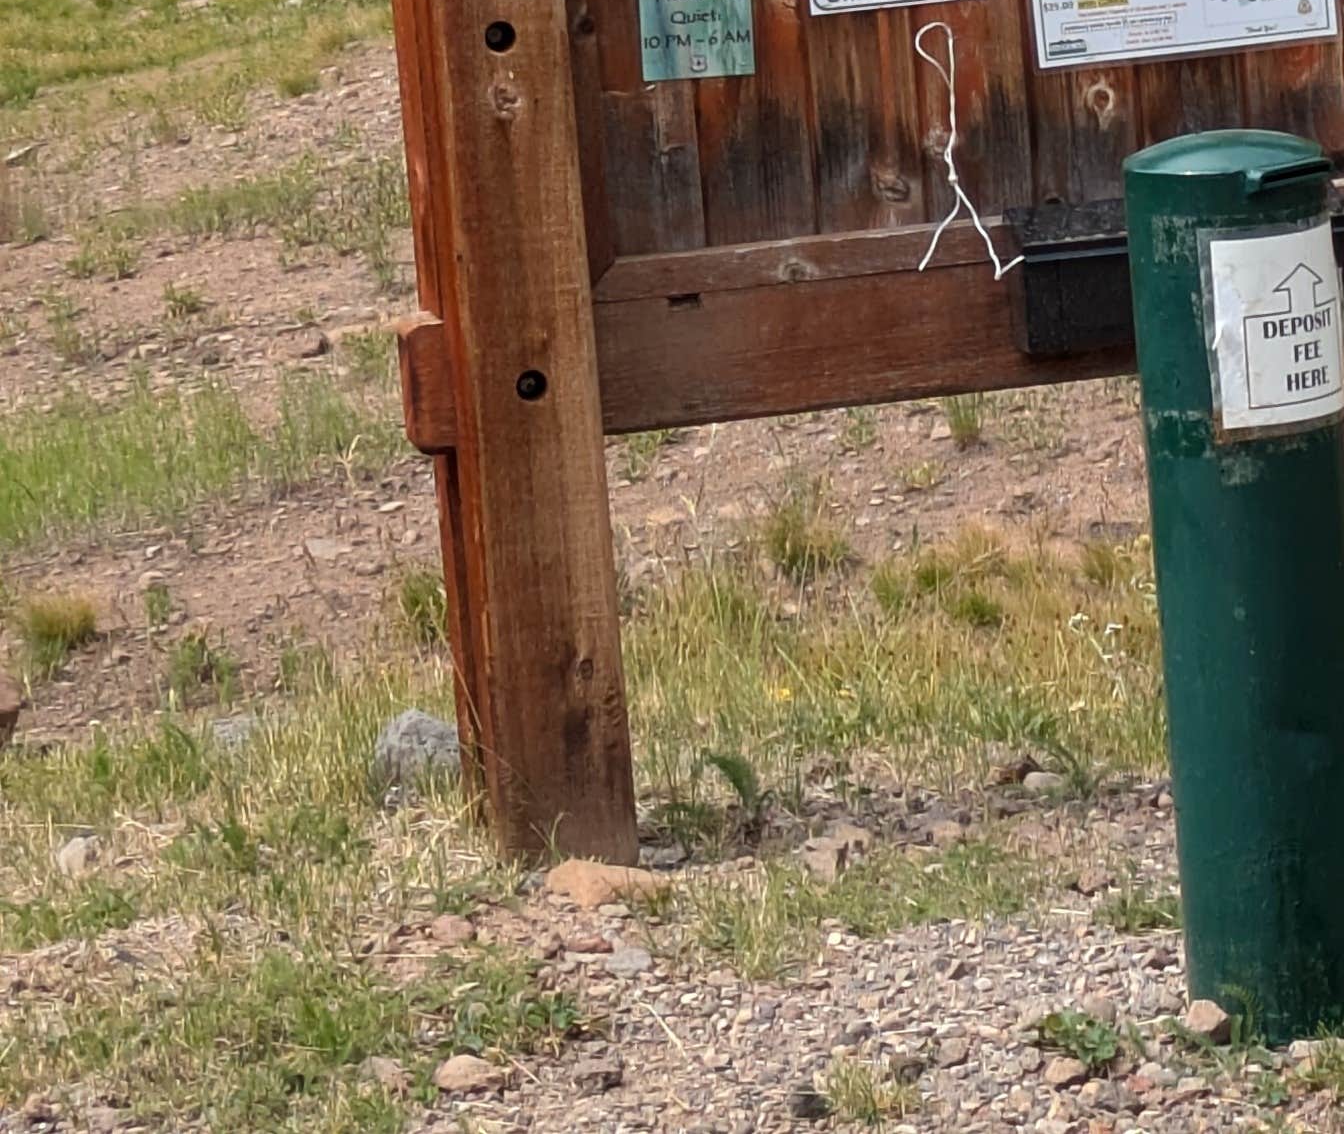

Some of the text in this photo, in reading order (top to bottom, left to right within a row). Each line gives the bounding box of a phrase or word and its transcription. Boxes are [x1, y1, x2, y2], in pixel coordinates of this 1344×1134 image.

[644, 36, 660, 49] 10
[665, 34, 692, 49] PM
[708, 30, 718, 46] 6
[722, 30, 751, 45] AM
[1263, 307, 1332, 340] DEPOSIT
[1293, 340, 1323, 363] FEE
[1286, 366, 1330, 392] HERE
